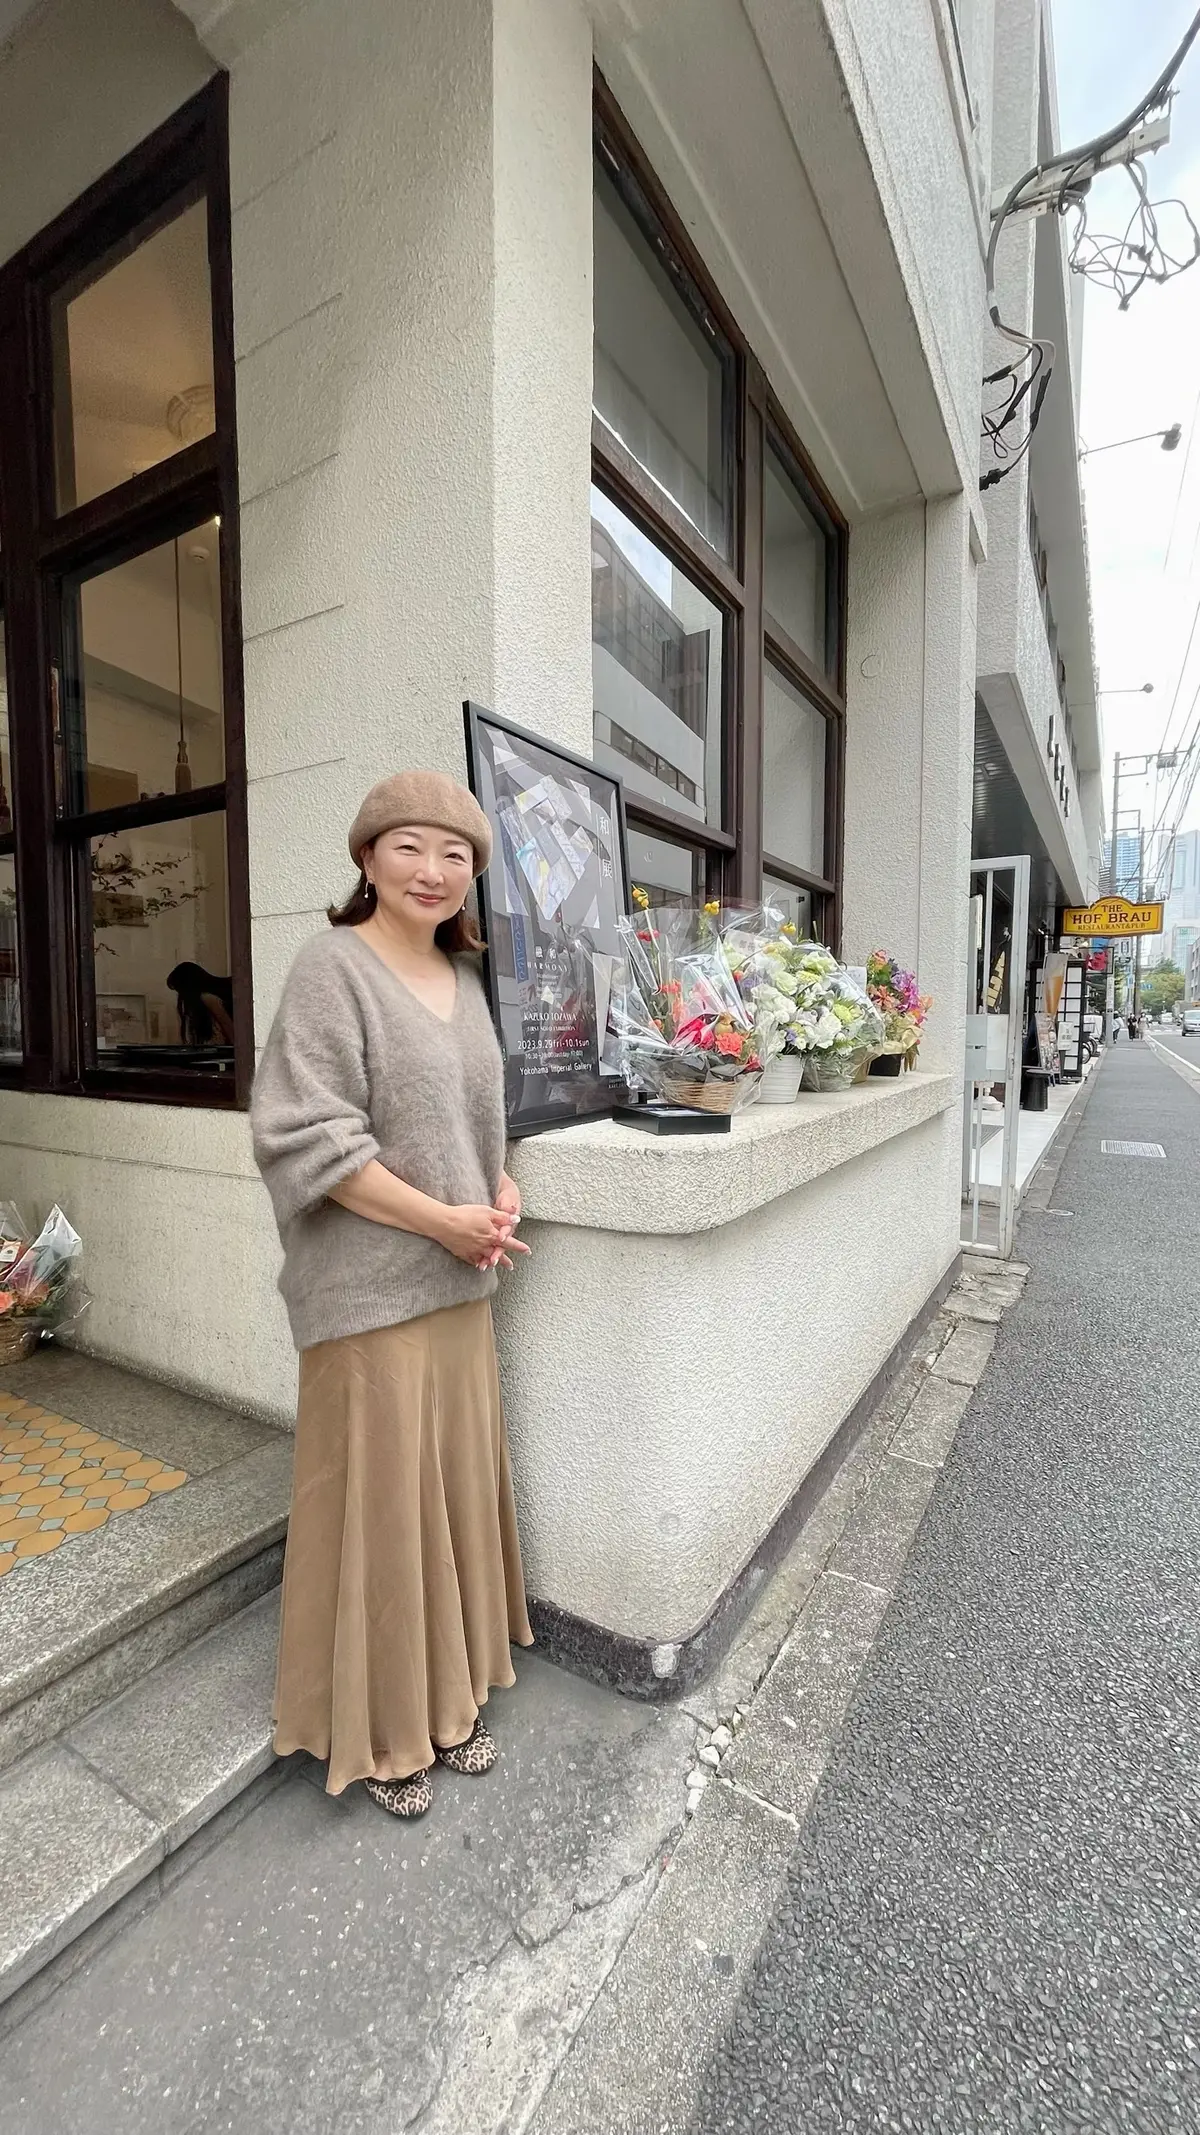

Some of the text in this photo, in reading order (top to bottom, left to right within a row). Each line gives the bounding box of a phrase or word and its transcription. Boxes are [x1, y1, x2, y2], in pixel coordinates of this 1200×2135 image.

[1101, 904, 1123, 913] THE
[1072, 911, 1151, 925] HOF BRAU
[519, 1066, 549, 1076] Yokohama
[574, 1061, 593, 1071] Gallery
